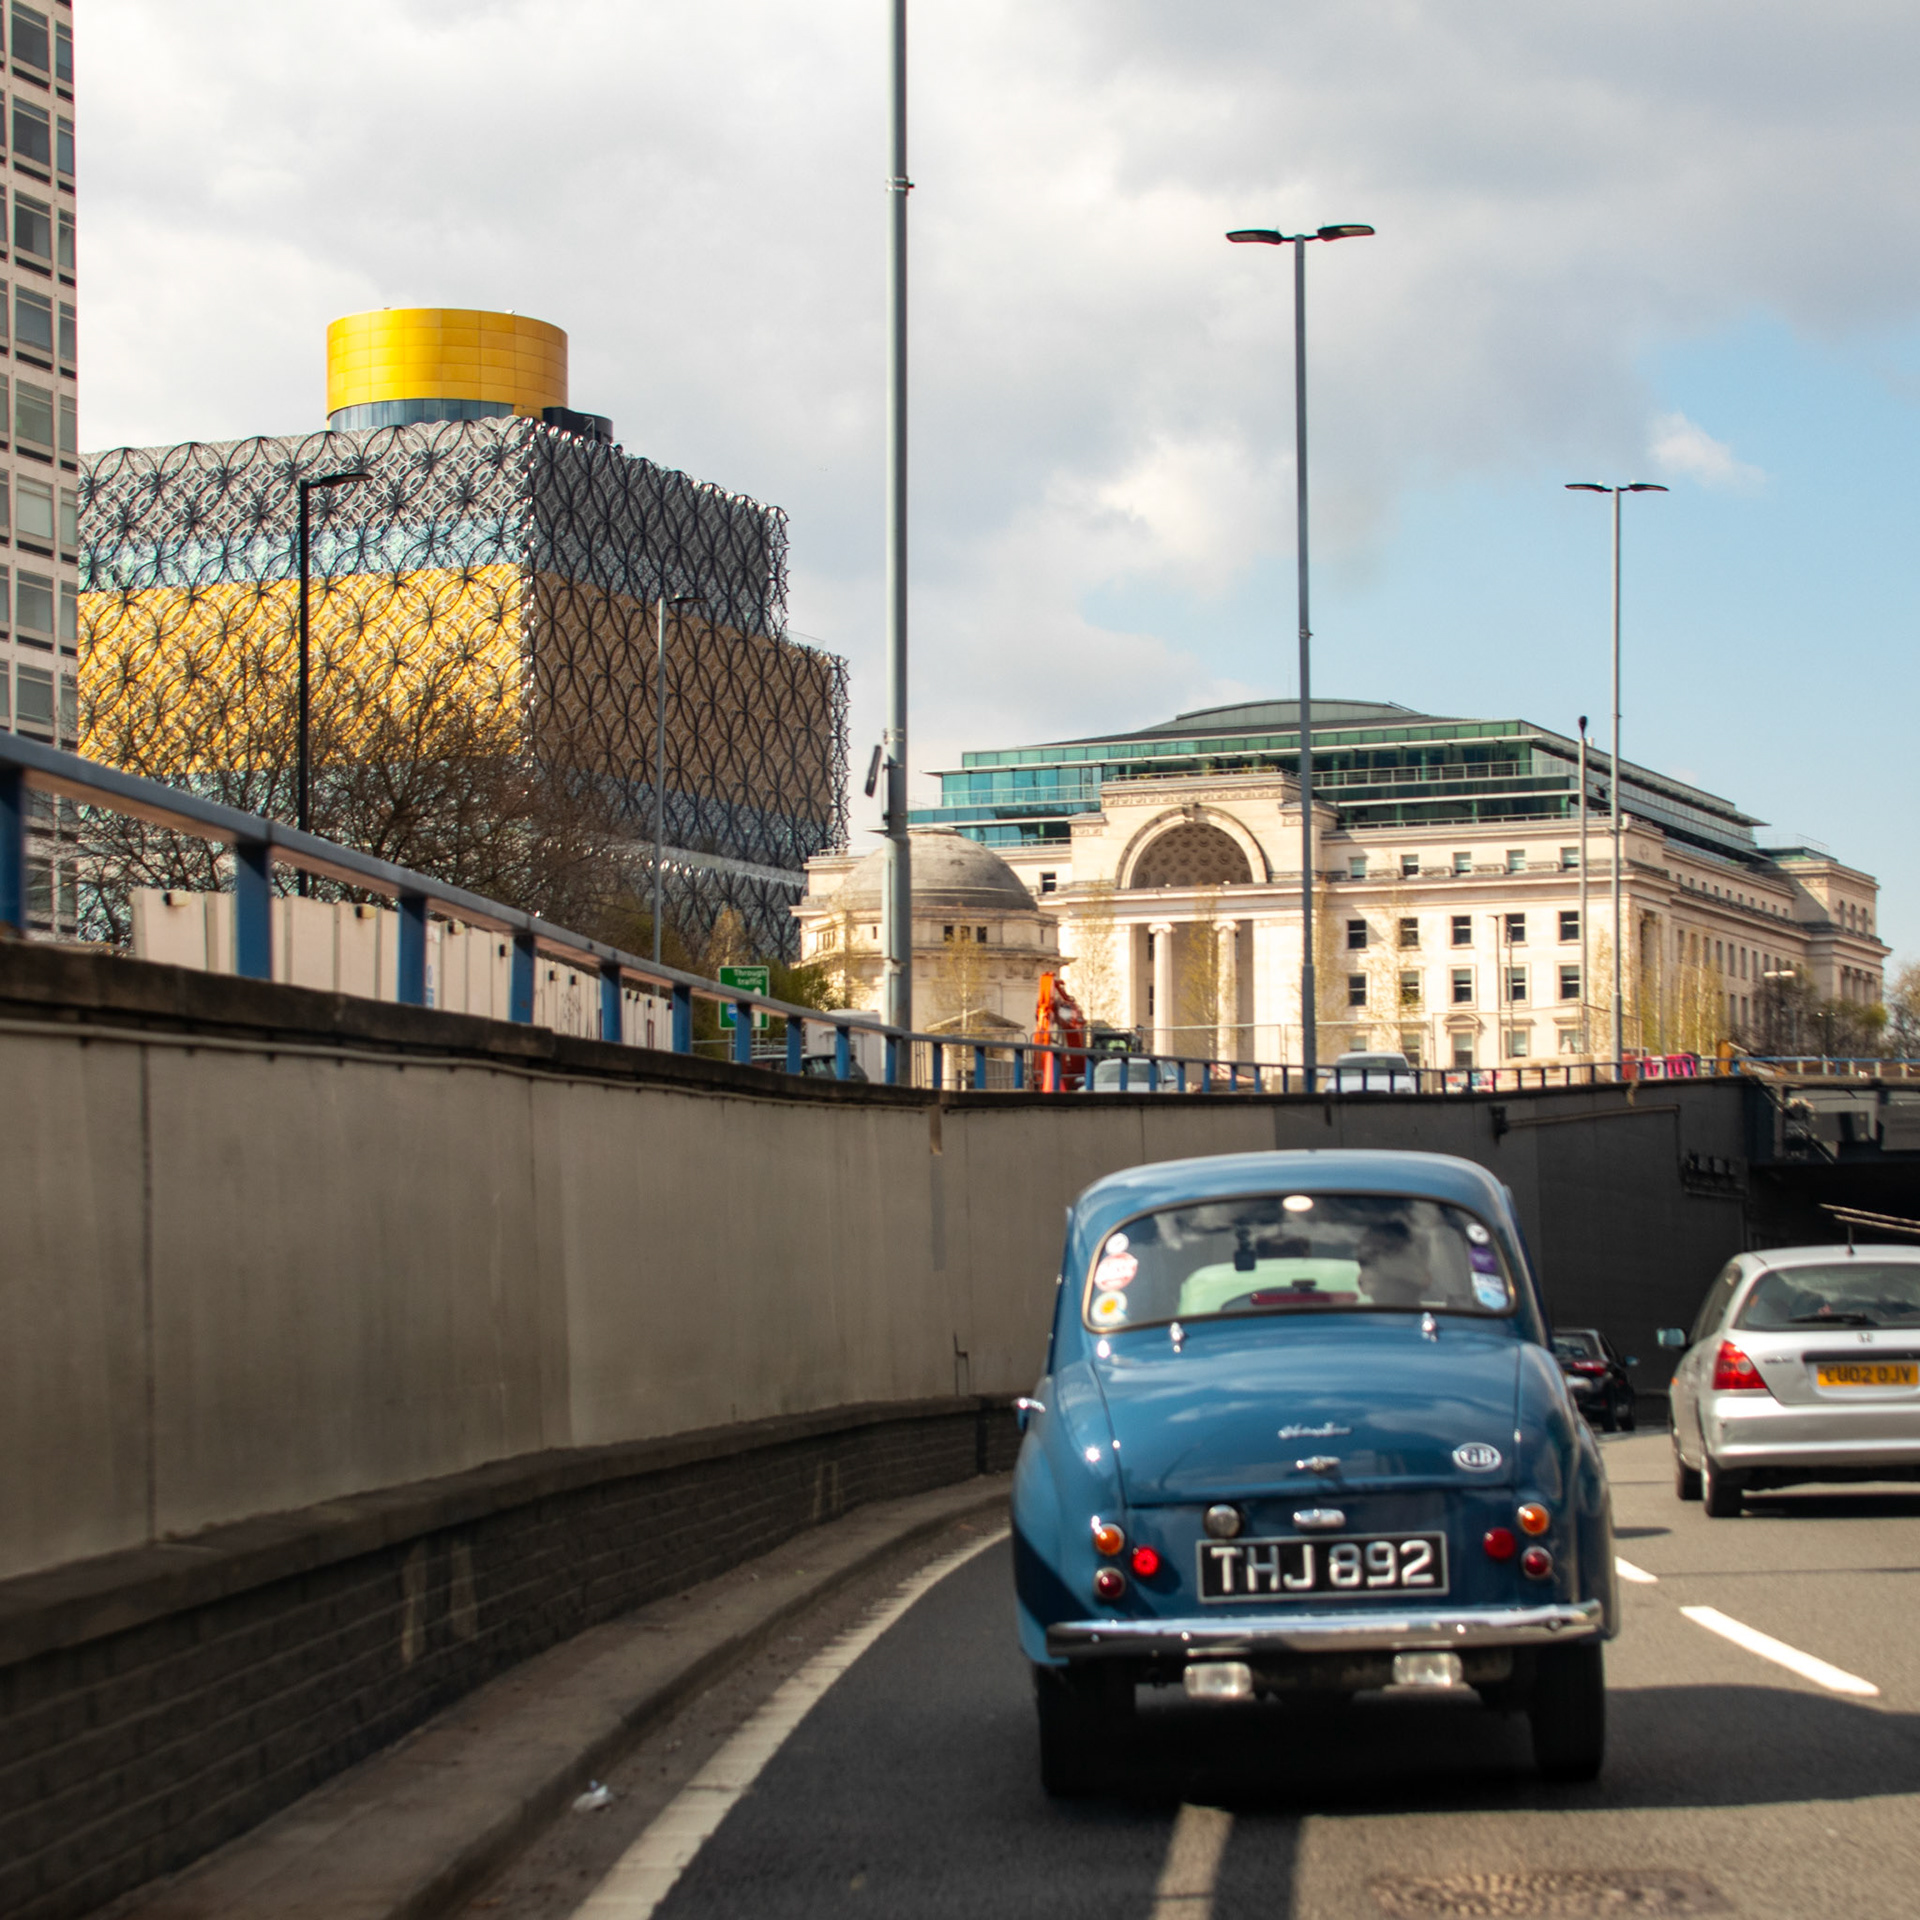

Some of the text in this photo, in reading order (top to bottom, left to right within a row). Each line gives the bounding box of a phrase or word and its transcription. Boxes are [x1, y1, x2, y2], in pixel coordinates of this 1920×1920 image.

[733, 969, 767, 978] Through
[737, 978, 763, 986] traffic
[1460, 1448, 1493, 1466] GB
[1210, 1539, 1435, 1593] THJ 892
